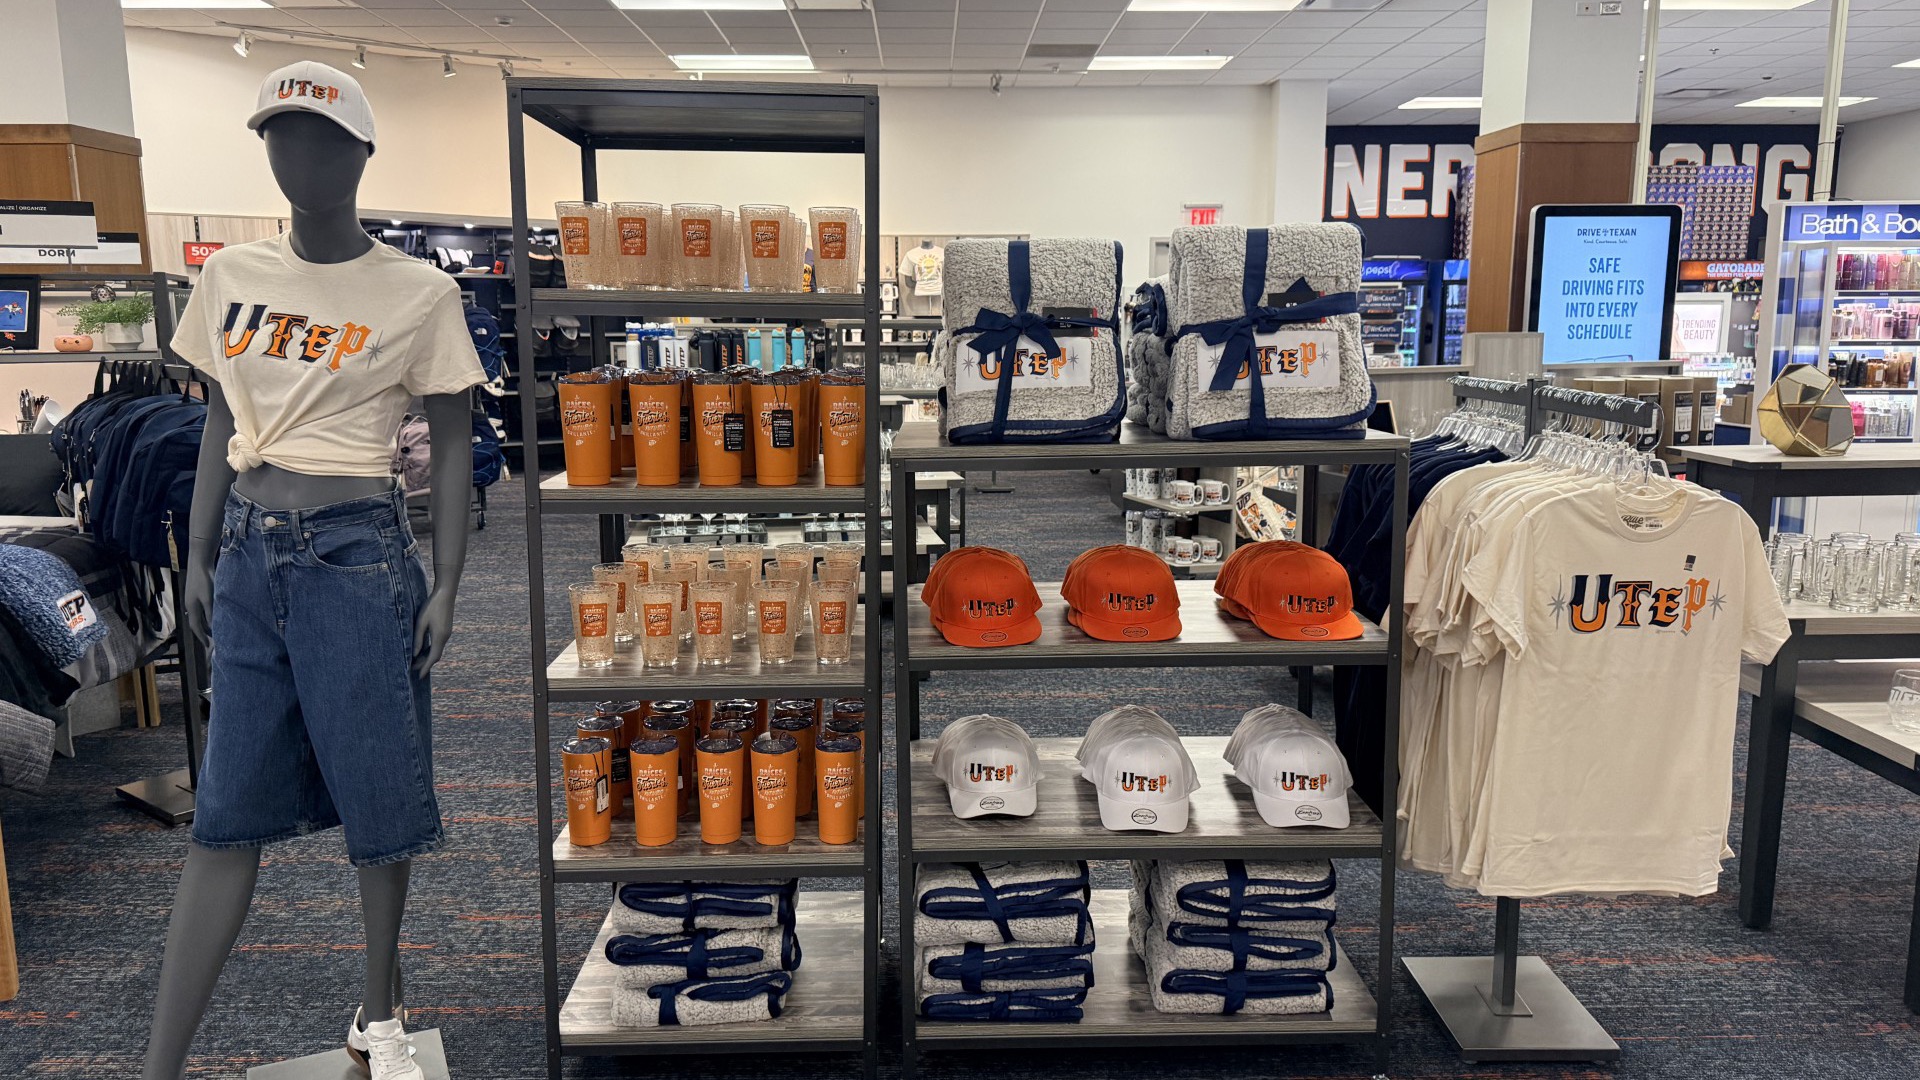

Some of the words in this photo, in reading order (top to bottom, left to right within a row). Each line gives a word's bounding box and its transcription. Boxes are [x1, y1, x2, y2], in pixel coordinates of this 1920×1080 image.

[278, 78, 339, 104] UTEP
[1322, 143, 1474, 219] NER
[1191, 208, 1216, 226] EXIT
[1801, 213, 1859, 235] Bath
[1862, 213, 1880, 234] &
[1577, 228, 1601, 237] DRIVE
[1609, 228, 1637, 237] TEXAN
[38, 249, 76, 257] DORM
[191, 245, 217, 256] 50%
[1588, 257, 1621, 273] SAFE
[1562, 279, 1614, 296] DRIVING
[1616, 279, 1645, 296] FITS
[1565, 301, 1595, 318] INTO
[1597, 301, 1638, 318] EVERY
[1567, 324, 1633, 340] SCHEDULE
[1682, 319, 1717, 329] TRENDING
[222, 302, 373, 376] UTEP
[1683, 329, 1715, 340] BEAUTY
[968, 597, 1015, 619] UTEP
[1107, 592, 1155, 612] UTEP
[1287, 594, 1335, 615] UTEP
[1568, 573, 1711, 637] UTEP
[969, 762, 1014, 783] UTEP
[1121, 771, 1167, 793] UTEP
[1281, 771, 1328, 792] UTEP
